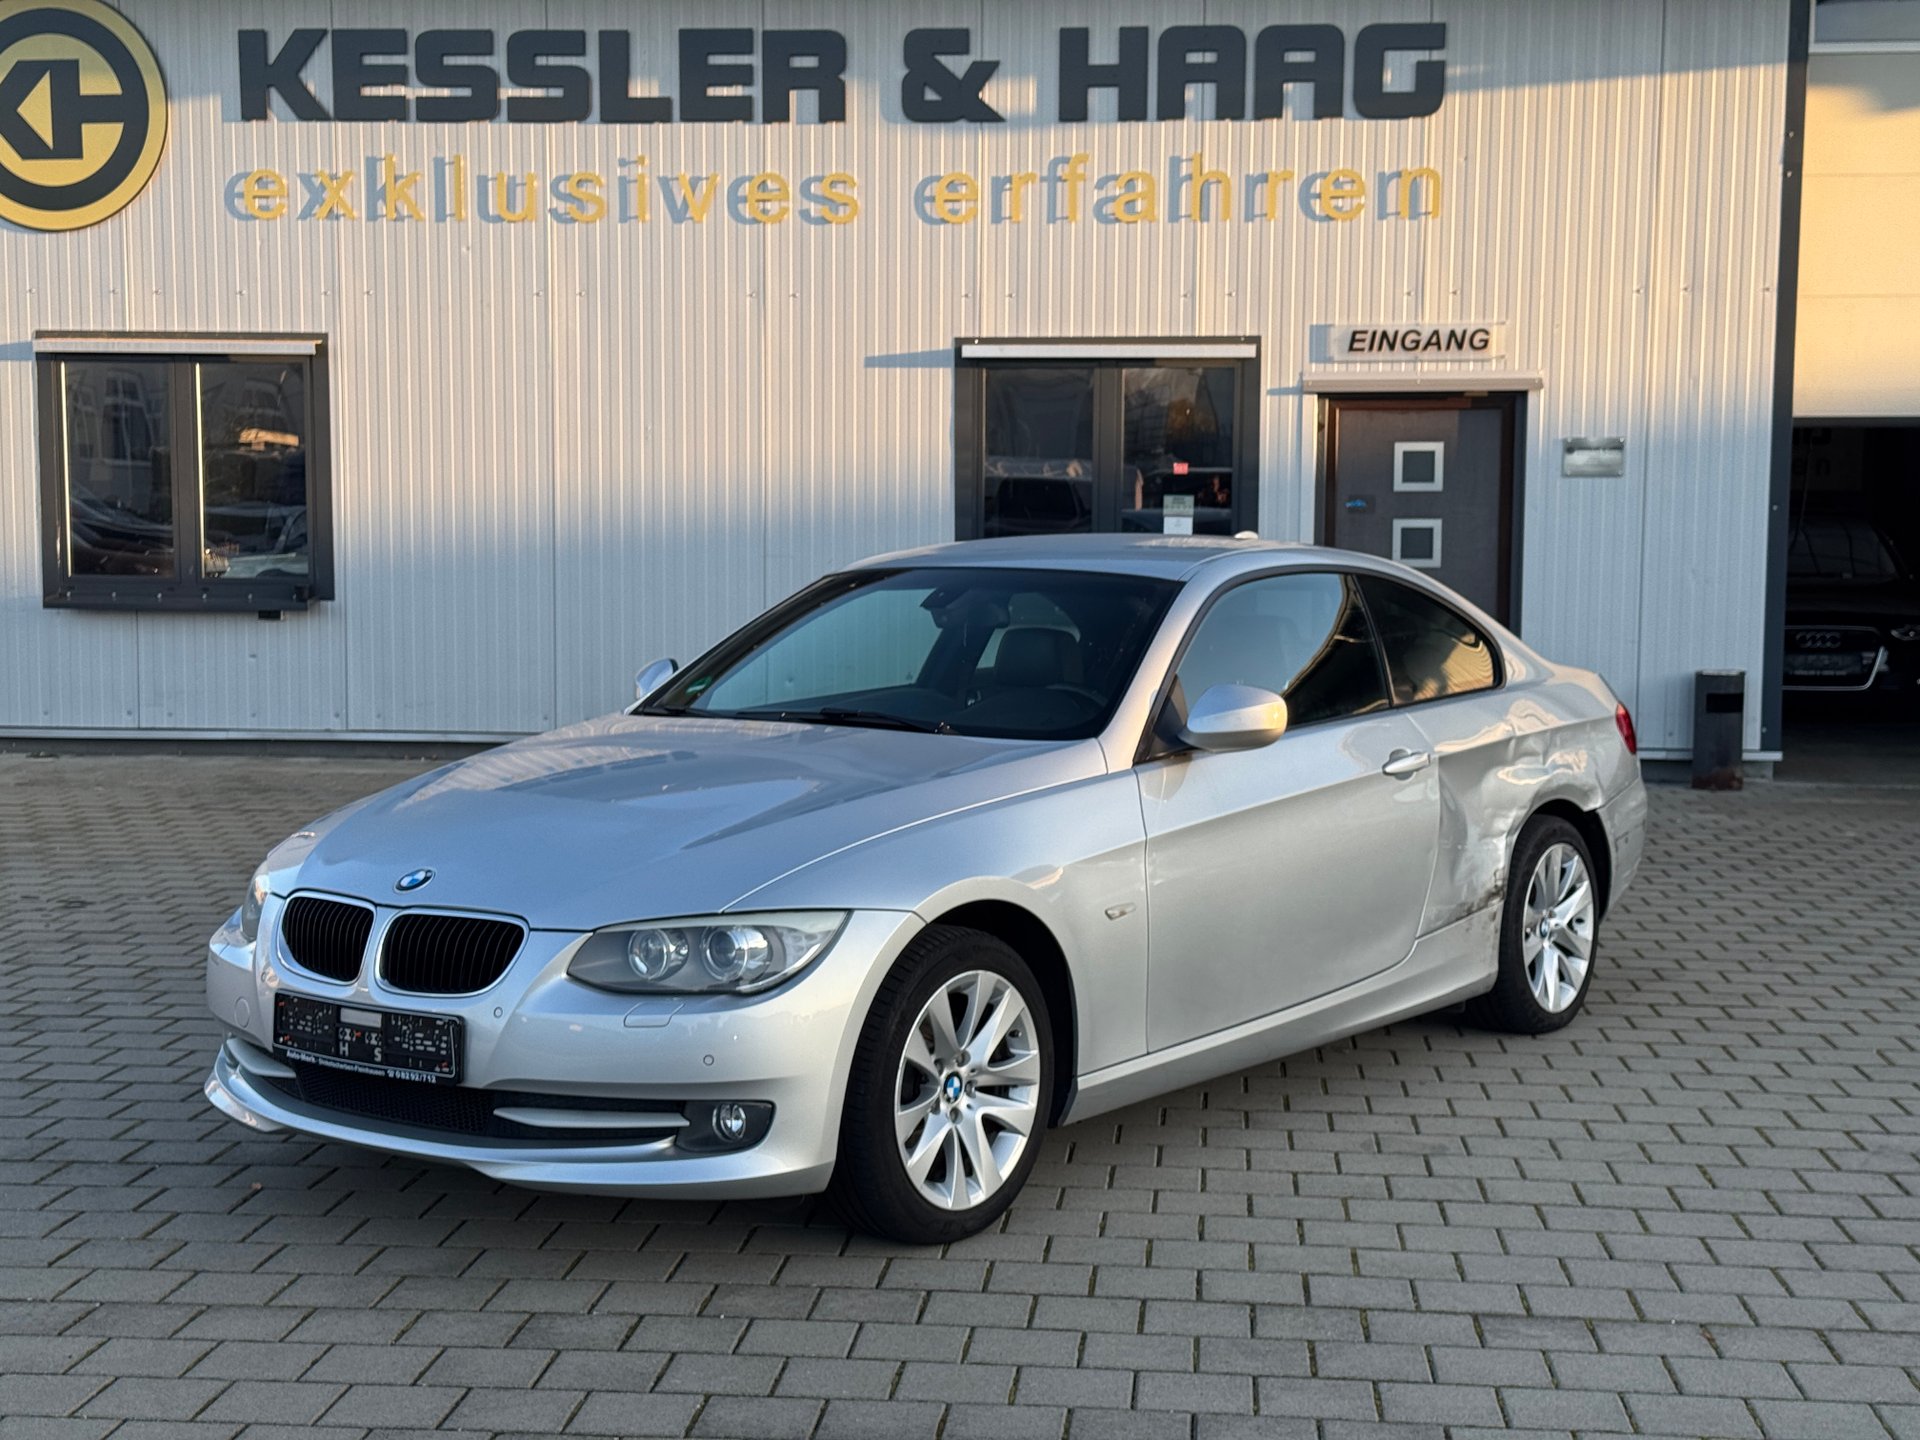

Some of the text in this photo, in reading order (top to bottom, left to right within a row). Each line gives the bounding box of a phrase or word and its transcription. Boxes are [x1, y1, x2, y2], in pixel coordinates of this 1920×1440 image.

[238, 23, 1447, 124] KESSLER & HAAG
[243, 152, 1442, 224] exklusives erfahren
[1348, 328, 1490, 353] EINGANG
